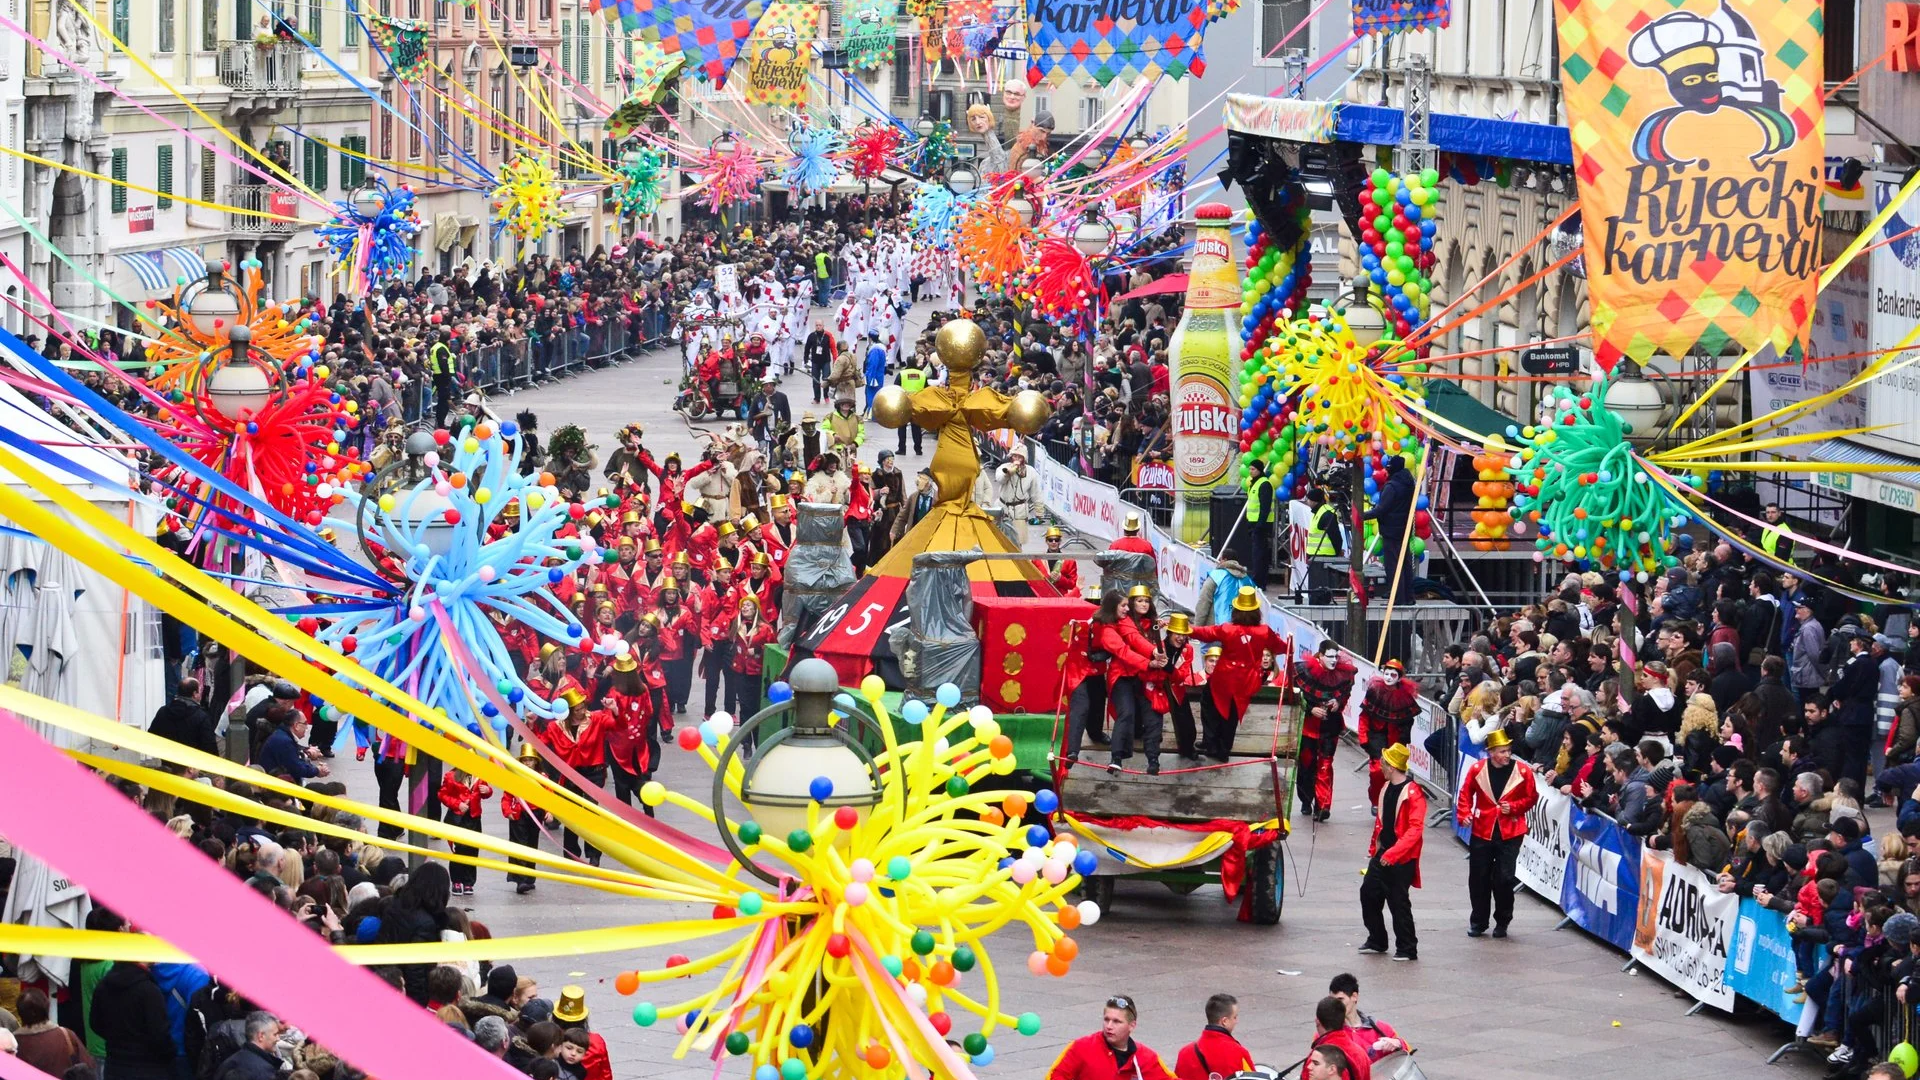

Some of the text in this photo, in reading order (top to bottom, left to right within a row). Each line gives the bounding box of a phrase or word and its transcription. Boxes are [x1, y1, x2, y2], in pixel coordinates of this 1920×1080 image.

[1618, 157, 1818, 238] Riječki
[1603, 215, 1823, 285] karneval
[1530, 352, 1569, 361] Bankomat
[1139, 465, 1174, 490] Ožujsko
[845, 602, 884, 636] 5
